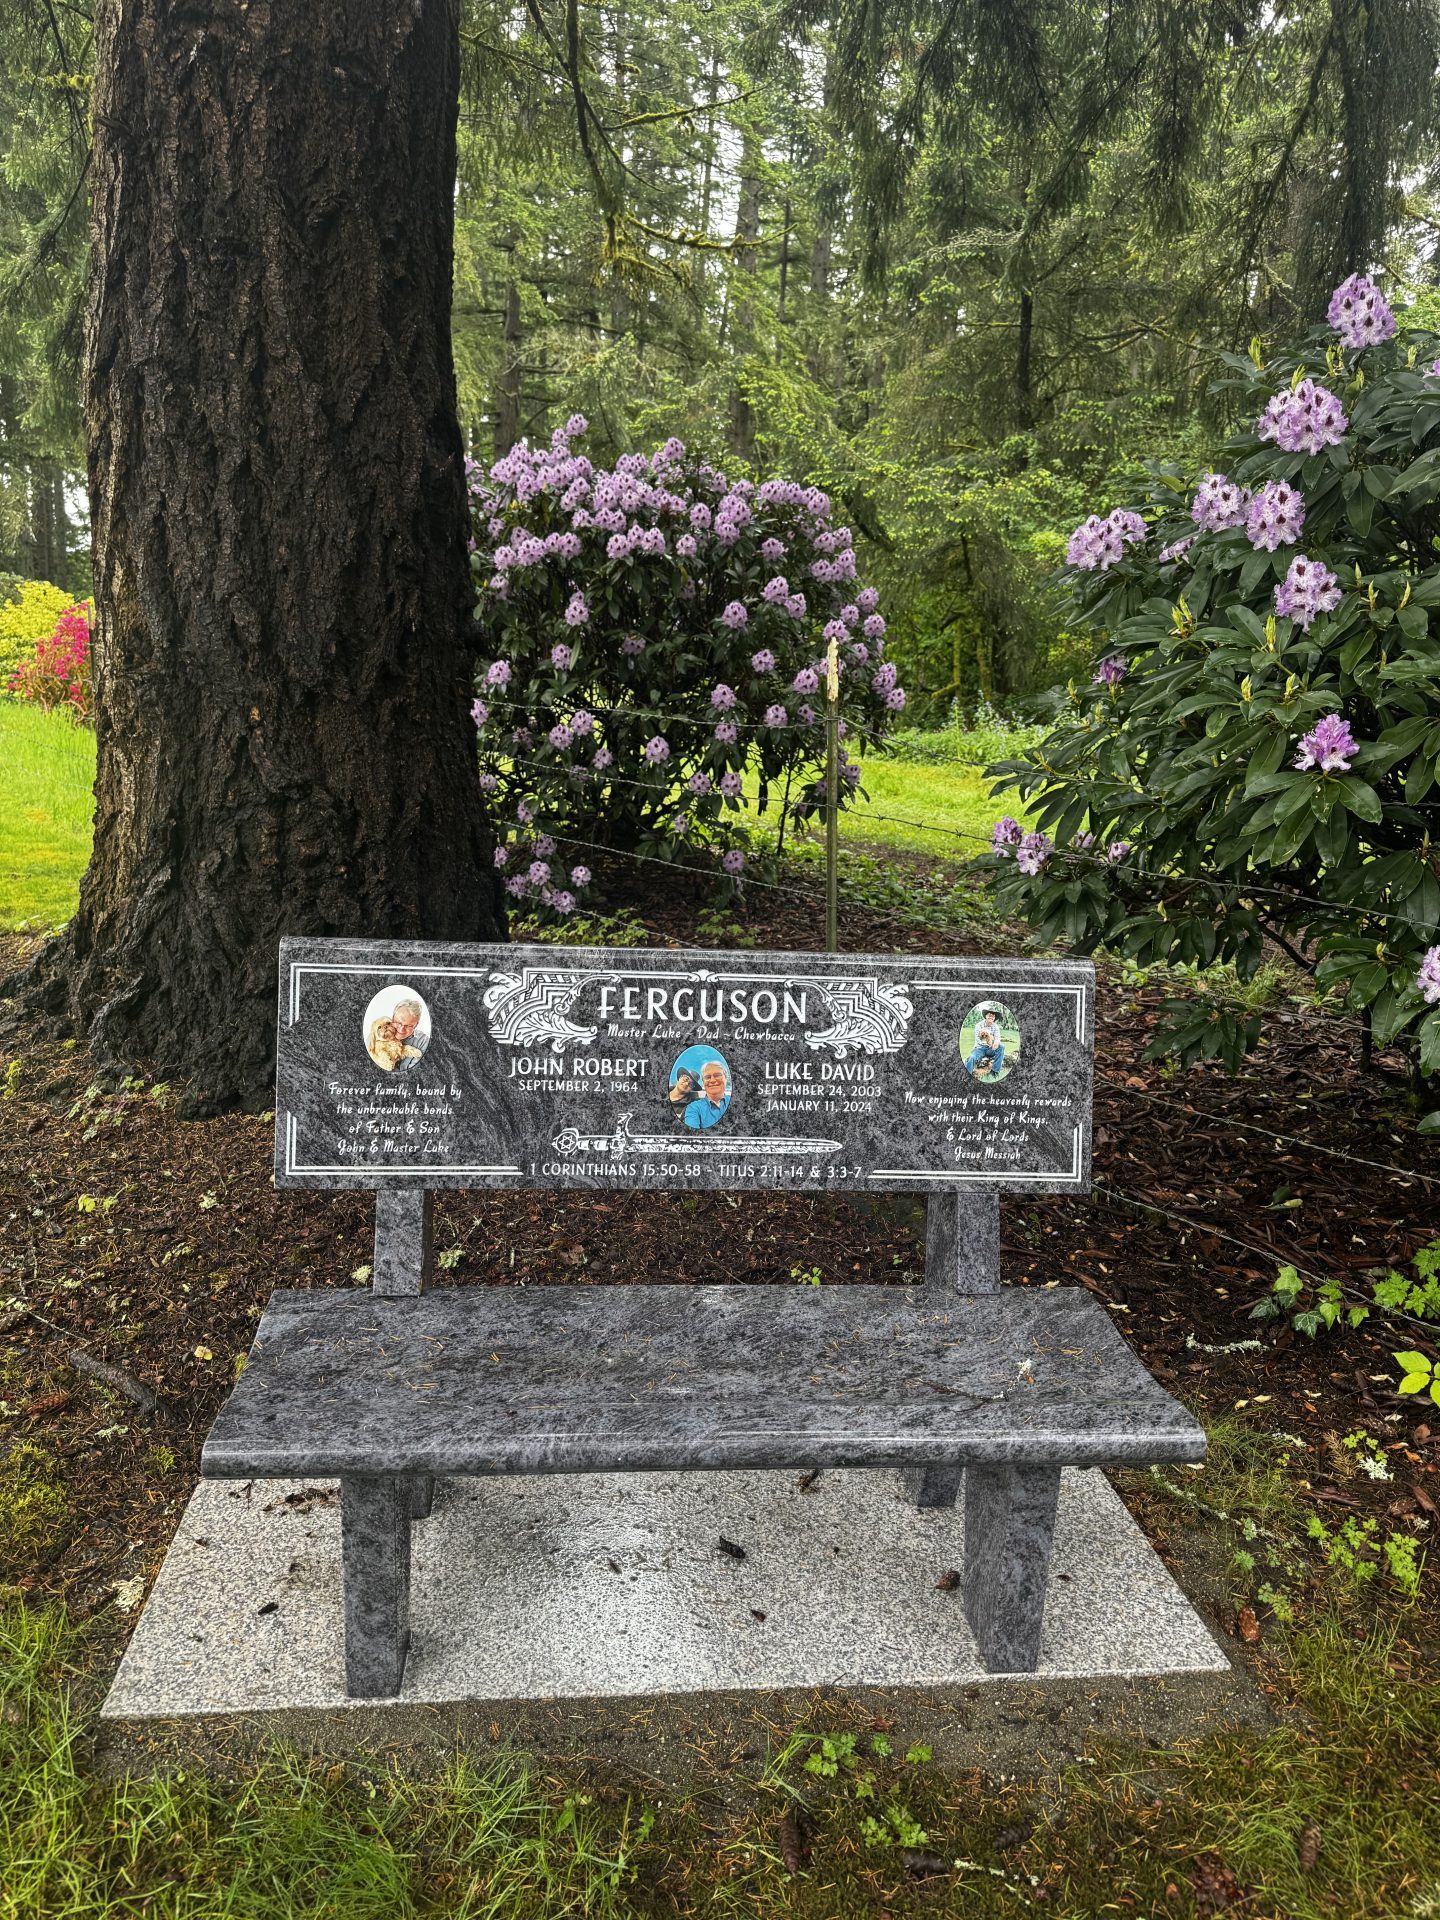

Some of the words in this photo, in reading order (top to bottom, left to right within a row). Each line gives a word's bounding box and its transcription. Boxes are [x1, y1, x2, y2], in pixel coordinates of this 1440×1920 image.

[597, 986, 807, 1023] FERGUSON
[607, 1023, 647, 1039] Master
[652, 1023, 681, 1039] Luke
[697, 1026, 720, 1041] Dad
[734, 1027, 795, 1042] Chewbacca
[509, 1057, 563, 1078] JOHN
[573, 1059, 649, 1077] ROBERT
[765, 1062, 813, 1080] LUKE
[820, 1063, 874, 1080] DAVID
[328, 1082, 371, 1097] Forever
[375, 1083, 412, 1099] family,
[416, 1084, 445, 1097] bound
[450, 1085, 461, 1099] by
[519, 1079, 589, 1092] SEPTEMBER
[593, 1080, 606, 1094] 2,
[611, 1081, 637, 1092] 1964
[758, 1083, 825, 1096] SEPTEMBER
[828, 1084, 846, 1099] 24,
[852, 1085, 881, 1097] 2003
[766, 1100, 820, 1113] JANUARY
[824, 1101, 838, 1114] 11,
[844, 1101, 872, 1113] 2024
[905, 1092, 925, 1105] Now
[929, 1094, 968, 1109] enjoying
[971, 1094, 986, 1105] the
[989, 1094, 1030, 1109] heavenly
[1034, 1095, 1072, 1107] rewards
[336, 1104, 352, 1114] the
[357, 1104, 419, 1115] unbreakable
[423, 1104, 452, 1116] bonds
[349, 1121, 362, 1135] of
[364, 1121, 401, 1134] Father
[406, 1119, 415, 1134] &
[419, 1121, 440, 1134] Son
[928, 1112, 948, 1123] with
[951, 1112, 974, 1123] their
[978, 1111, 999, 1126] King
[1004, 1112, 1015, 1125] of
[1018, 1111, 1048, 1127] Kings,
[946, 1127, 954, 1142] &
[958, 1128, 982, 1141] Lord
[986, 1129, 997, 1142] of
[1002, 1130, 1029, 1142] Lords
[337, 1140, 365, 1155] John
[370, 1137, 378, 1153] &
[383, 1141, 419, 1154] Master
[423, 1141, 449, 1154] Luke
[954, 1146, 981, 1161] Jesus
[985, 1146, 1021, 1160] Messiah
[530, 1164, 536, 1176] 1
[542, 1163, 636, 1176] CORINTHIANS
[643, 1163, 701, 1178] 15:50-58
[718, 1165, 754, 1177] TITUS
[761, 1165, 803, 1178] 2:11-14
[810, 1166, 819, 1178] &
[828, 1166, 861, 1178] 3:3-7
